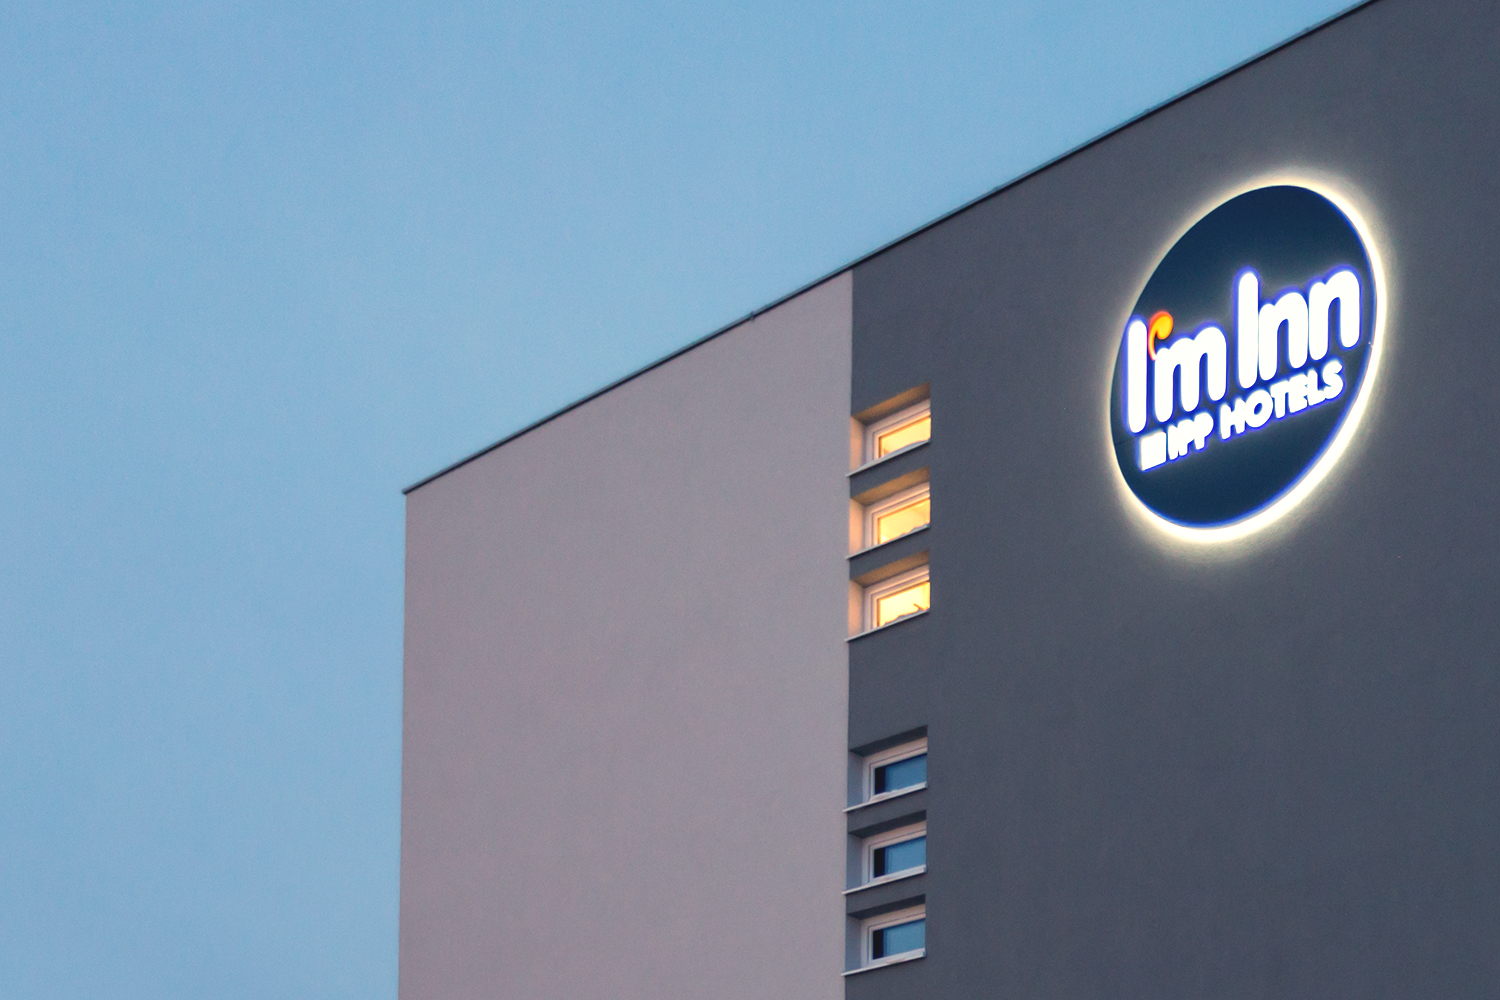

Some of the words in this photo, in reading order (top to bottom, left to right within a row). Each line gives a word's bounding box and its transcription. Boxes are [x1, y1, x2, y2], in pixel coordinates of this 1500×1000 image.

[1126, 310, 1228, 434] I'm
[1235, 268, 1361, 390] Inn
[1167, 411, 1215, 461] IPP
[1219, 360, 1345, 441] HOTELS
